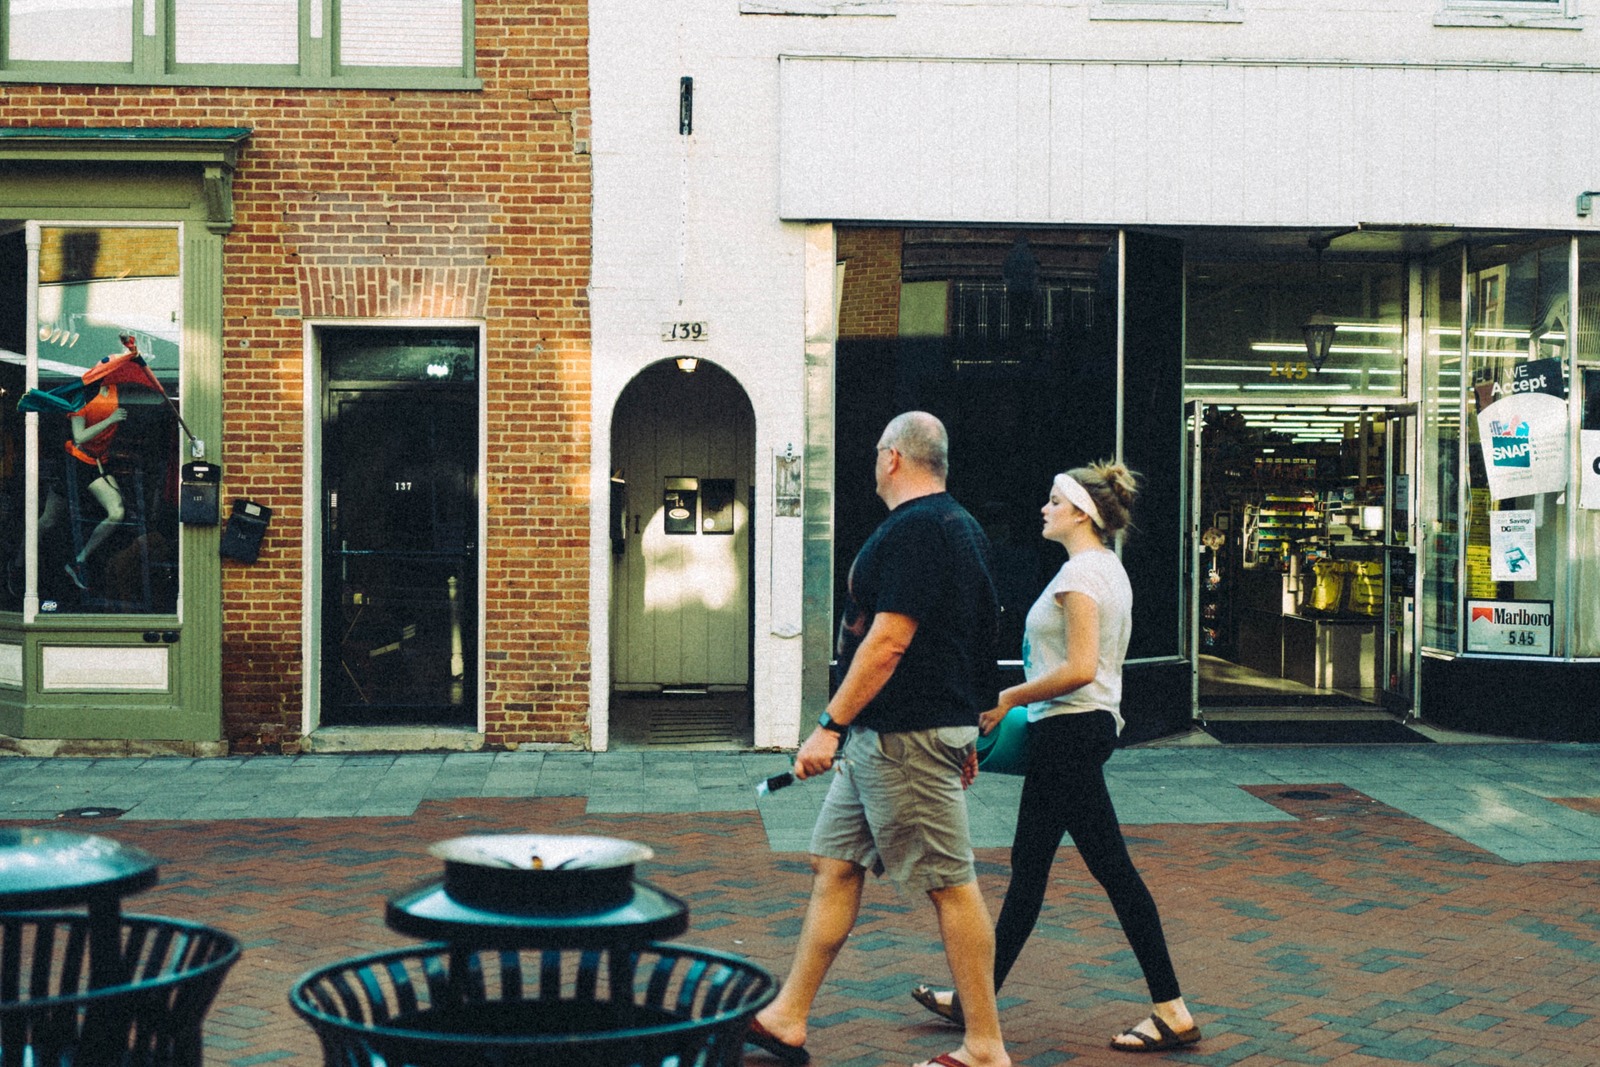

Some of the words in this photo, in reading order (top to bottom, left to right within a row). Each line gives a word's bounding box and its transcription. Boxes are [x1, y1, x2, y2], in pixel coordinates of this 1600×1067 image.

[672, 322, 702, 339] 139
[1269, 361, 1308, 380] 145
[1504, 364, 1529, 379] WE
[1491, 374, 1547, 397] Accept
[1493, 443, 1530, 461] SNAP
[395, 482, 412, 491] 137
[1494, 608, 1551, 626] Marlboro
